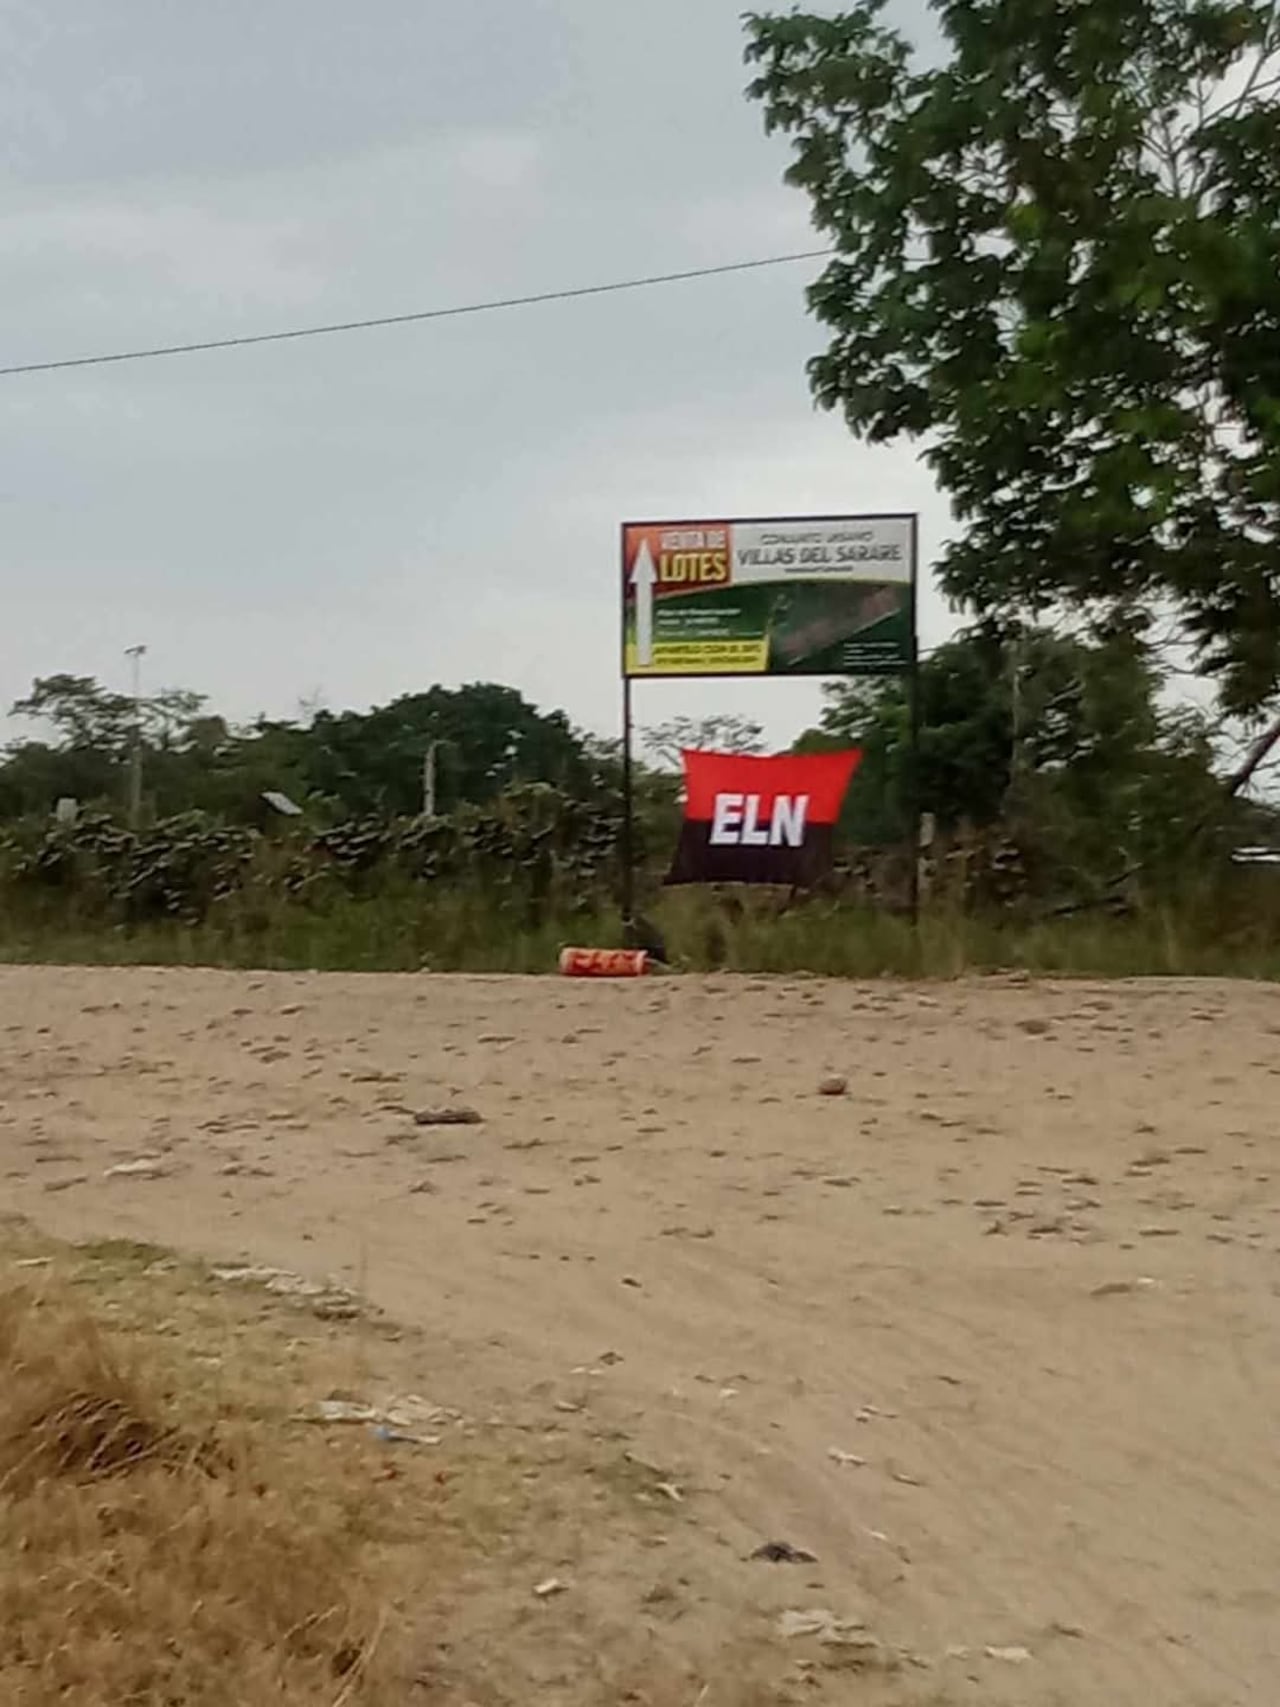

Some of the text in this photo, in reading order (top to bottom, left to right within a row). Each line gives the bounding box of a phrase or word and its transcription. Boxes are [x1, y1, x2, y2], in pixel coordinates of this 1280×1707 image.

[661, 552, 726, 582] LOTES
[738, 544, 903, 566] VILLAS DEL SARARE
[709, 793, 810, 847] ELN
